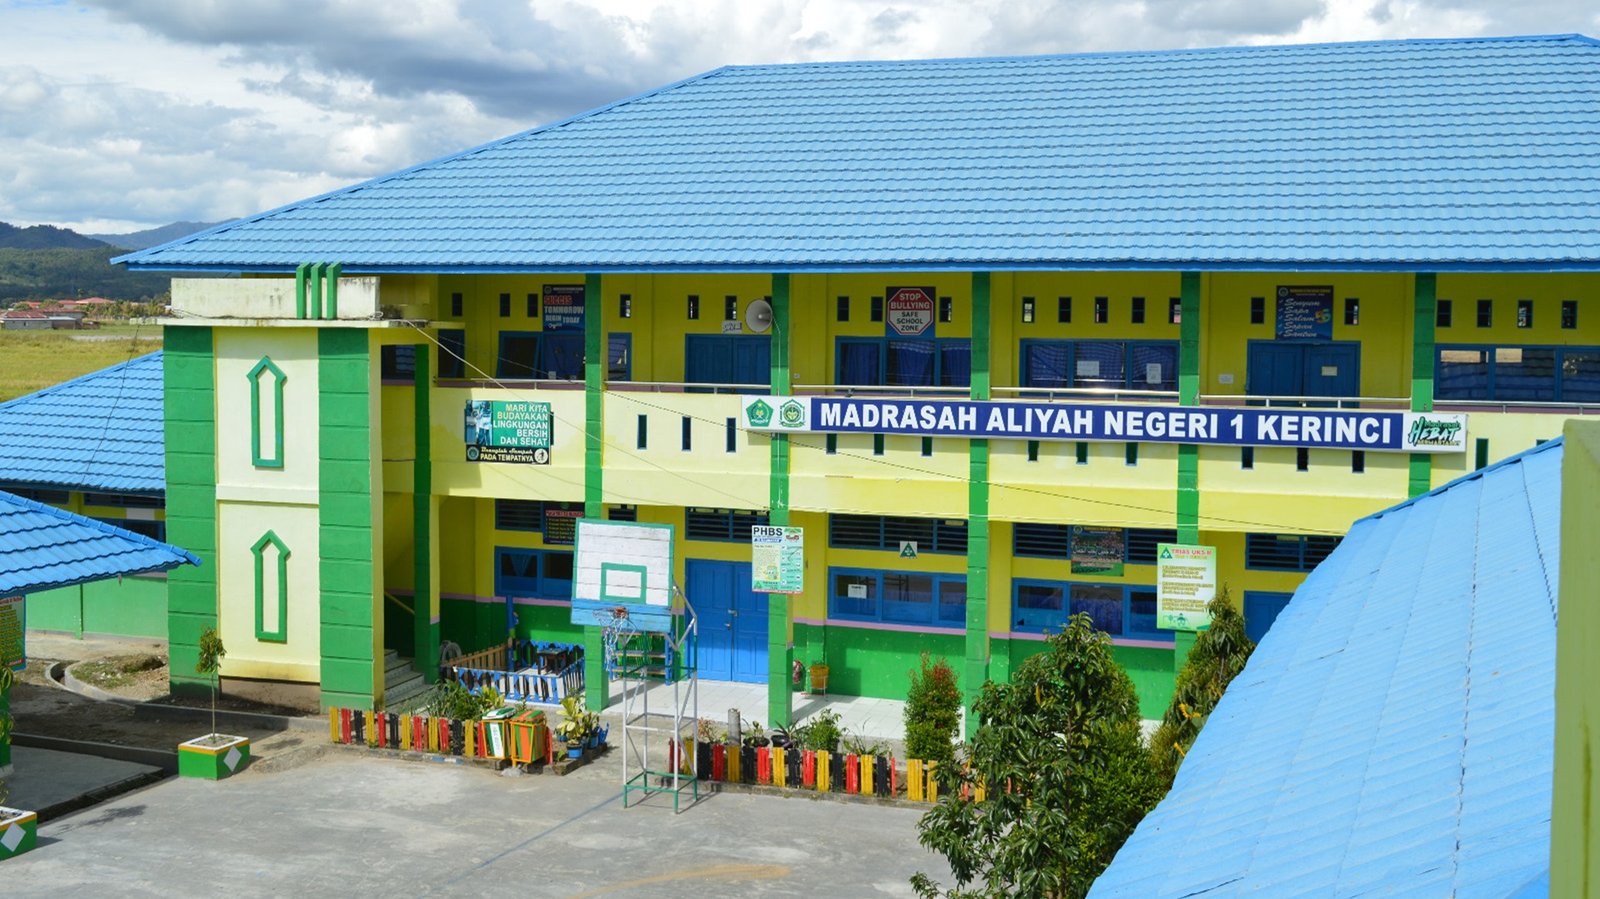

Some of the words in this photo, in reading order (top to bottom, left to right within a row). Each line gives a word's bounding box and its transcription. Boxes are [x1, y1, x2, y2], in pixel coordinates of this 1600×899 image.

[563, 316, 580, 324] TODAY
[497, 412, 548, 420] BUDAYAKAN
[493, 420, 548, 429] LINGKUNGAN
[820, 403, 977, 430] MADRASAH
[986, 407, 1093, 434] ALIYAH
[1104, 410, 1218, 439] NEGERI
[1230, 414, 1244, 439] 1
[1257, 415, 1391, 444] KERINCI
[517, 429, 547, 437] BERSIH
[498, 454, 534, 462] TEMPATNYA
[753, 527, 783, 536] PHBS
